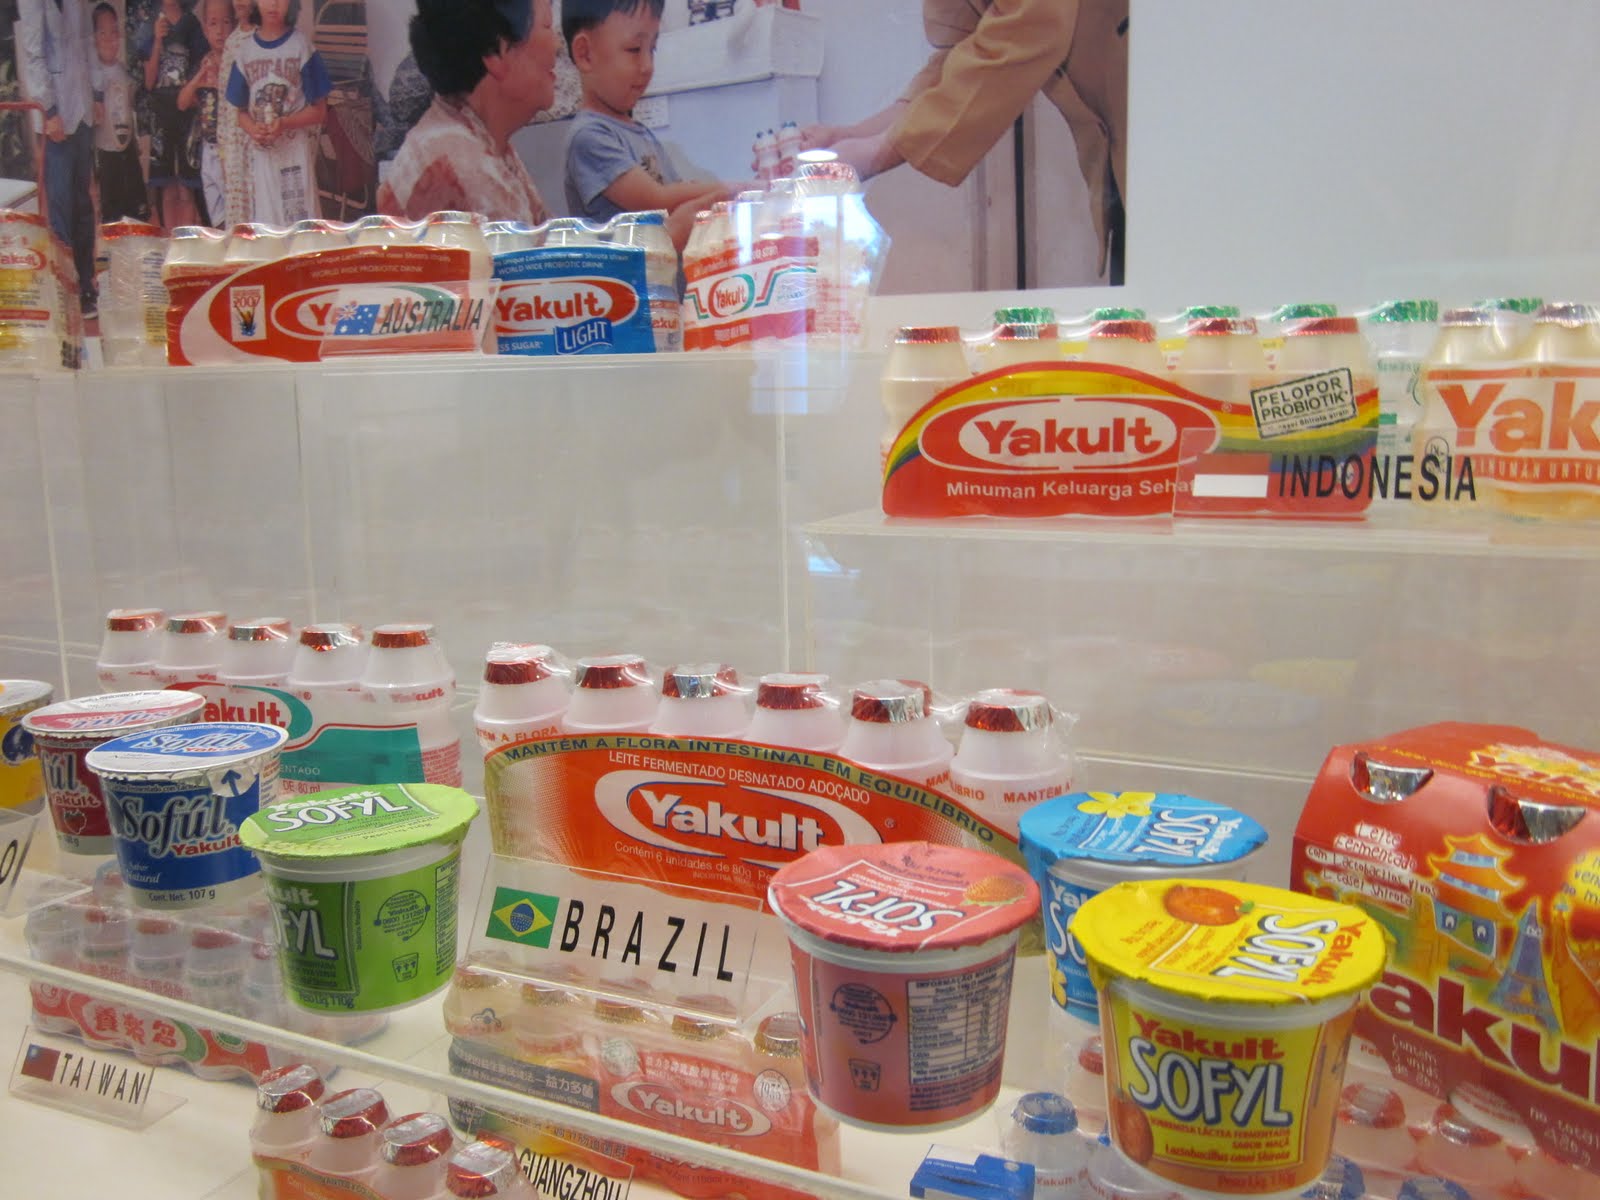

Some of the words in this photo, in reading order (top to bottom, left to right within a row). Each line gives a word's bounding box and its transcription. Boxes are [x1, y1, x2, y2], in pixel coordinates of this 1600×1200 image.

[379, 299, 484, 334] AUSTRALIA
[495, 292, 604, 322] Yakult
[715, 285, 747, 309] Yakult
[563, 321, 607, 351] LIGHT
[1258, 376, 1343, 408] PELOPOR
[974, 417, 1163, 457] Yakult
[946, 482, 1036, 499] Minuman
[1043, 480, 1133, 501] Keluarga
[1278, 453, 1477, 501] INDONESIA
[1549, 462, 1600, 480] UNTU
[203, 696, 287, 728] akult
[515, 725, 558, 741] FLORA
[282, 780, 295, 793] DE
[298, 781, 308, 794] 80
[504, 738, 588, 762] MANTÉM
[597, 738, 609, 748] A
[617, 736, 680, 751] FLORA
[688, 739, 815, 768] INTESTINAL
[823, 757, 851, 780] EM
[859, 772, 994, 843] EQUILÍBRIO
[609, 751, 640, 767] LEITE
[643, 755, 726, 779] FERMENTADO
[729, 768, 805, 791] DESNATADO
[808, 778, 870, 805] ADOÇADO
[121, 796, 227, 858] Sofúl
[267, 796, 408, 833] SOFYL
[637, 789, 825, 850] Yakult
[1131, 810, 1219, 858] SOFYL
[170, 833, 241, 857] Yakult
[615, 841, 654, 859] Contém
[656, 854, 663, 863] 6
[666, 855, 713, 871] unidades
[716, 862, 730, 871] de
[732, 865, 752, 880] 80g
[1308, 846, 1328, 860] com
[189, 889, 206, 899] 107
[209, 889, 216, 900] g
[812, 879, 966, 932] SOFYL
[559, 899, 734, 983] BRAZIL
[1209, 914, 1338, 983] SOFYL
[1301, 919, 1368, 986] Yakult
[1130, 1012, 1285, 1061] Yakult
[1369, 970, 1600, 1104] aku
[59, 1053, 146, 1105] TAIWAN
[1128, 1035, 1294, 1128] SOFYL
[635, 1087, 749, 1130] Yakult
[518, 1148, 623, 1200] GUANGZHOU
